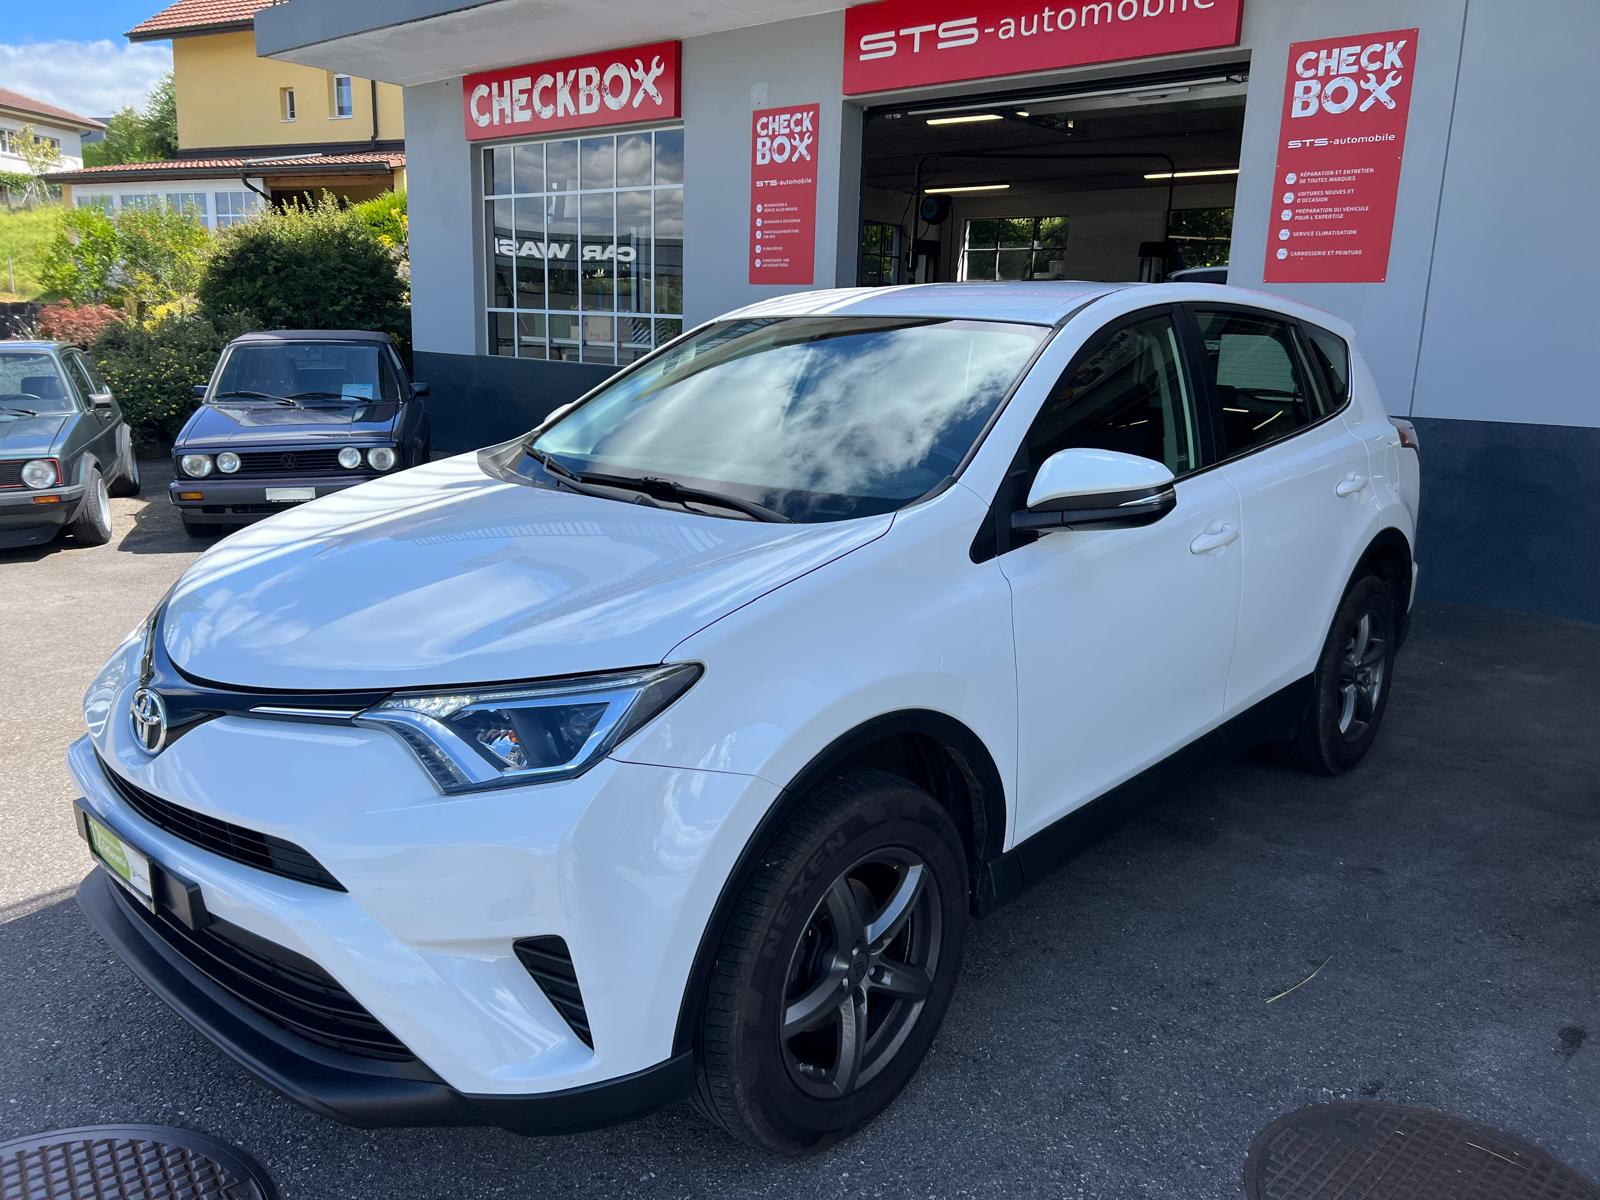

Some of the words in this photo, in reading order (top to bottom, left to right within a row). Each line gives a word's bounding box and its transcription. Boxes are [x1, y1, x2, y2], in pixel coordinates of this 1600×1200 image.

[1295, 40, 1408, 78] CHECK
[470, 55, 665, 127] CHECKBOX
[1291, 70, 1403, 118] BOX
[756, 111, 814, 136] CHECK
[1287, 133, 1396, 149] STS-automobile
[756, 132, 813, 165] BOX
[1343, 167, 1375, 175] ENTRETIEN
[762, 830, 848, 959] NEXEN
